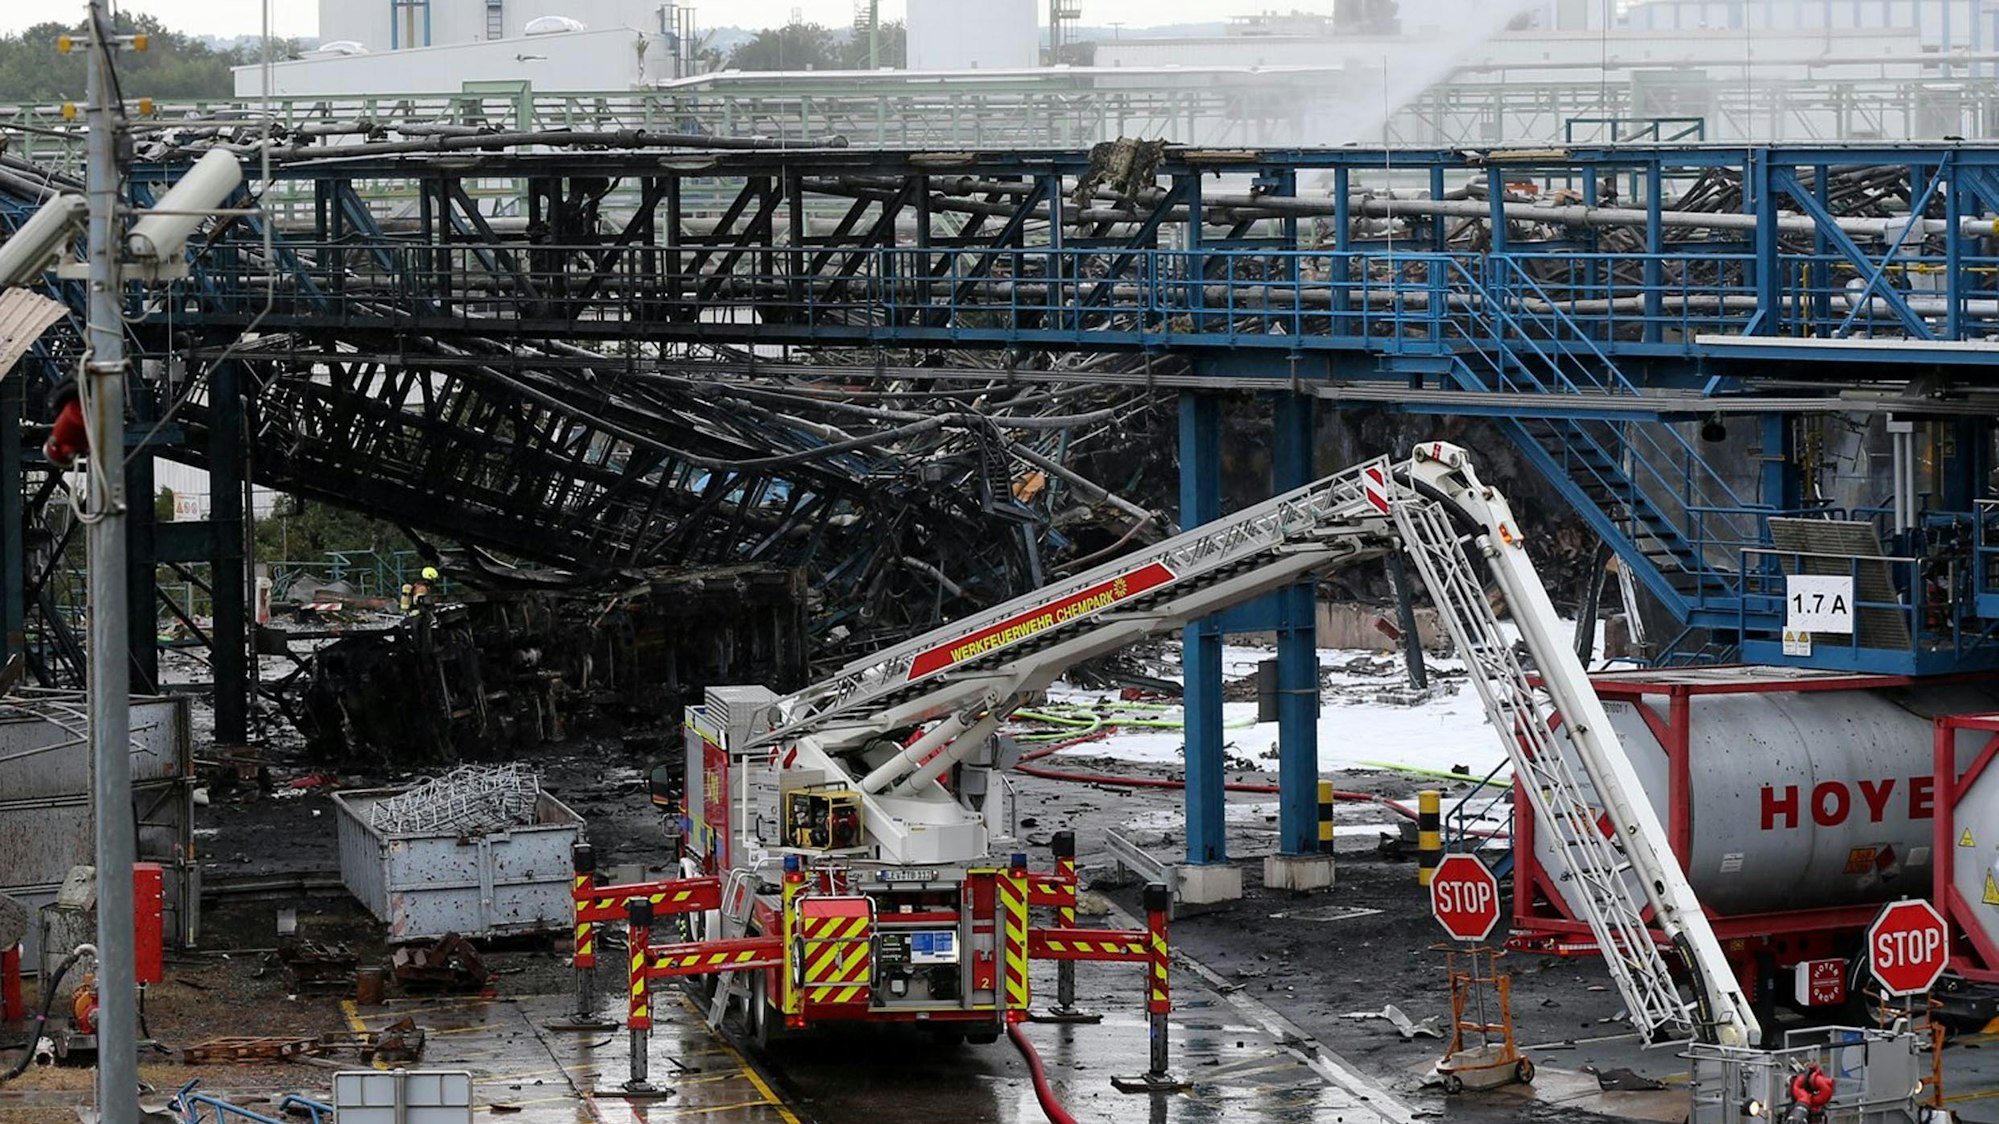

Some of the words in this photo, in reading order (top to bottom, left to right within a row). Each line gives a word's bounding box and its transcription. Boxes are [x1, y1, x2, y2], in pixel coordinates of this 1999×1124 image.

[1793, 593, 1825, 614] 1.7
[1831, 594, 1847, 615] A
[951, 614, 1054, 663] WERKFEUERWEHR
[1056, 590, 1116, 624] CHEMPARK
[1761, 775, 1964, 830] HOYE
[1438, 881, 1491, 914] STOP
[1878, 927, 1940, 968] STOP
[981, 978, 990, 989] 2
